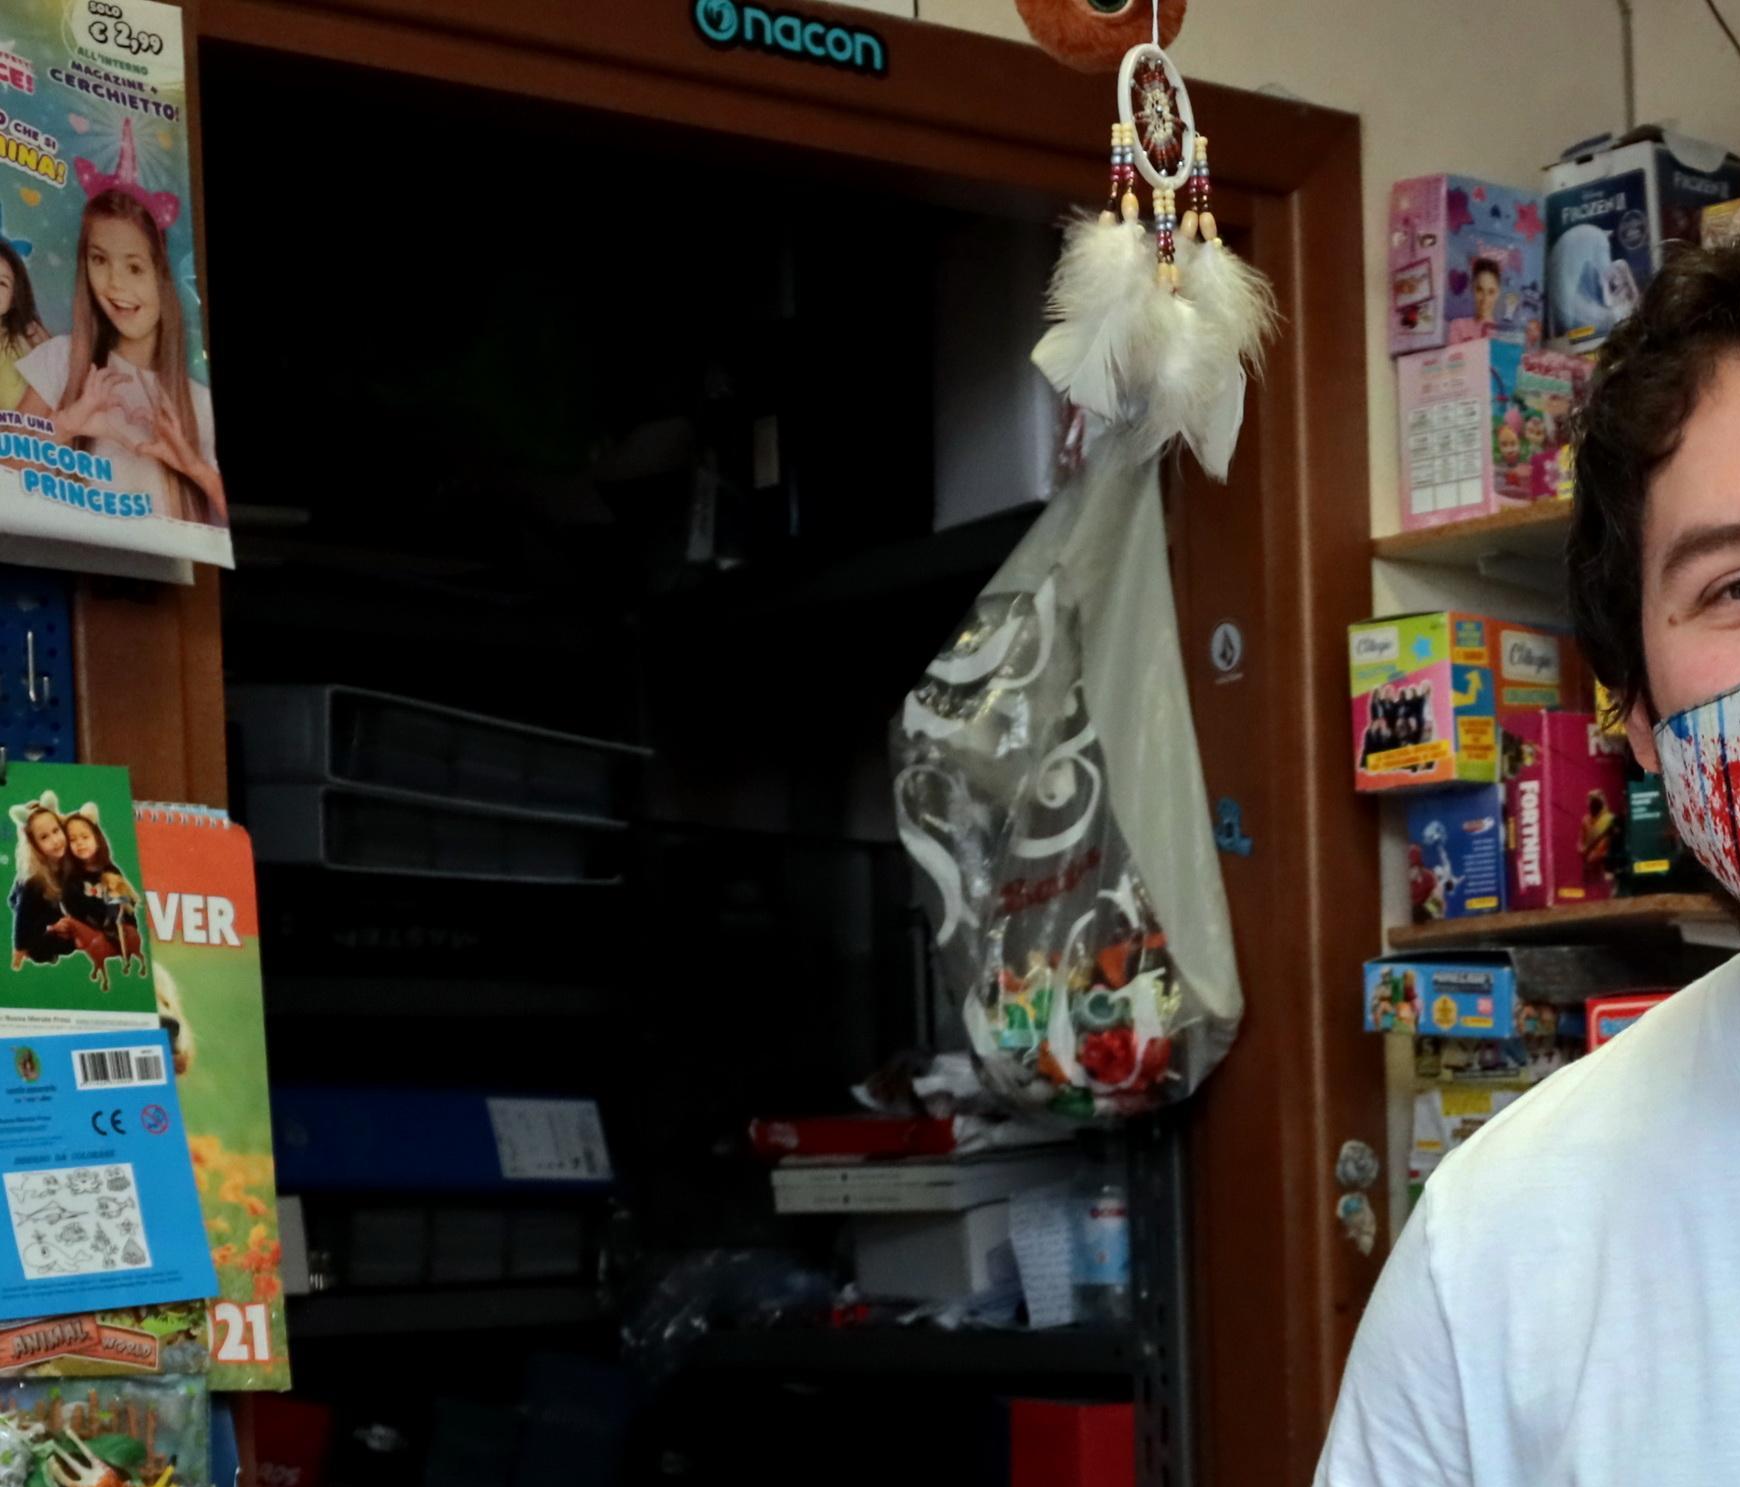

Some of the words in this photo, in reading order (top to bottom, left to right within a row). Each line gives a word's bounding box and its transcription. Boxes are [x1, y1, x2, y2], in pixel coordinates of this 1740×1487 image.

[88, 1, 122, 19] SOLO
[114, 21, 163, 55] 2,99
[743, 6, 883, 70] nacon
[50, 69, 179, 122] CERCHIETTO!
[71, 61, 145, 92] MAGAZINE
[14, 122, 38, 141] CHE
[44, 136, 56, 149] SI
[27, 417, 54, 433] UNA
[0, 434, 112, 482] UNICORN
[24, 469, 153, 517] PRINCESS!
[1518, 780, 1543, 889] FORTNITE
[10, 1318, 91, 1360] ANIMAL
[101, 1336, 153, 1360] WORLD
